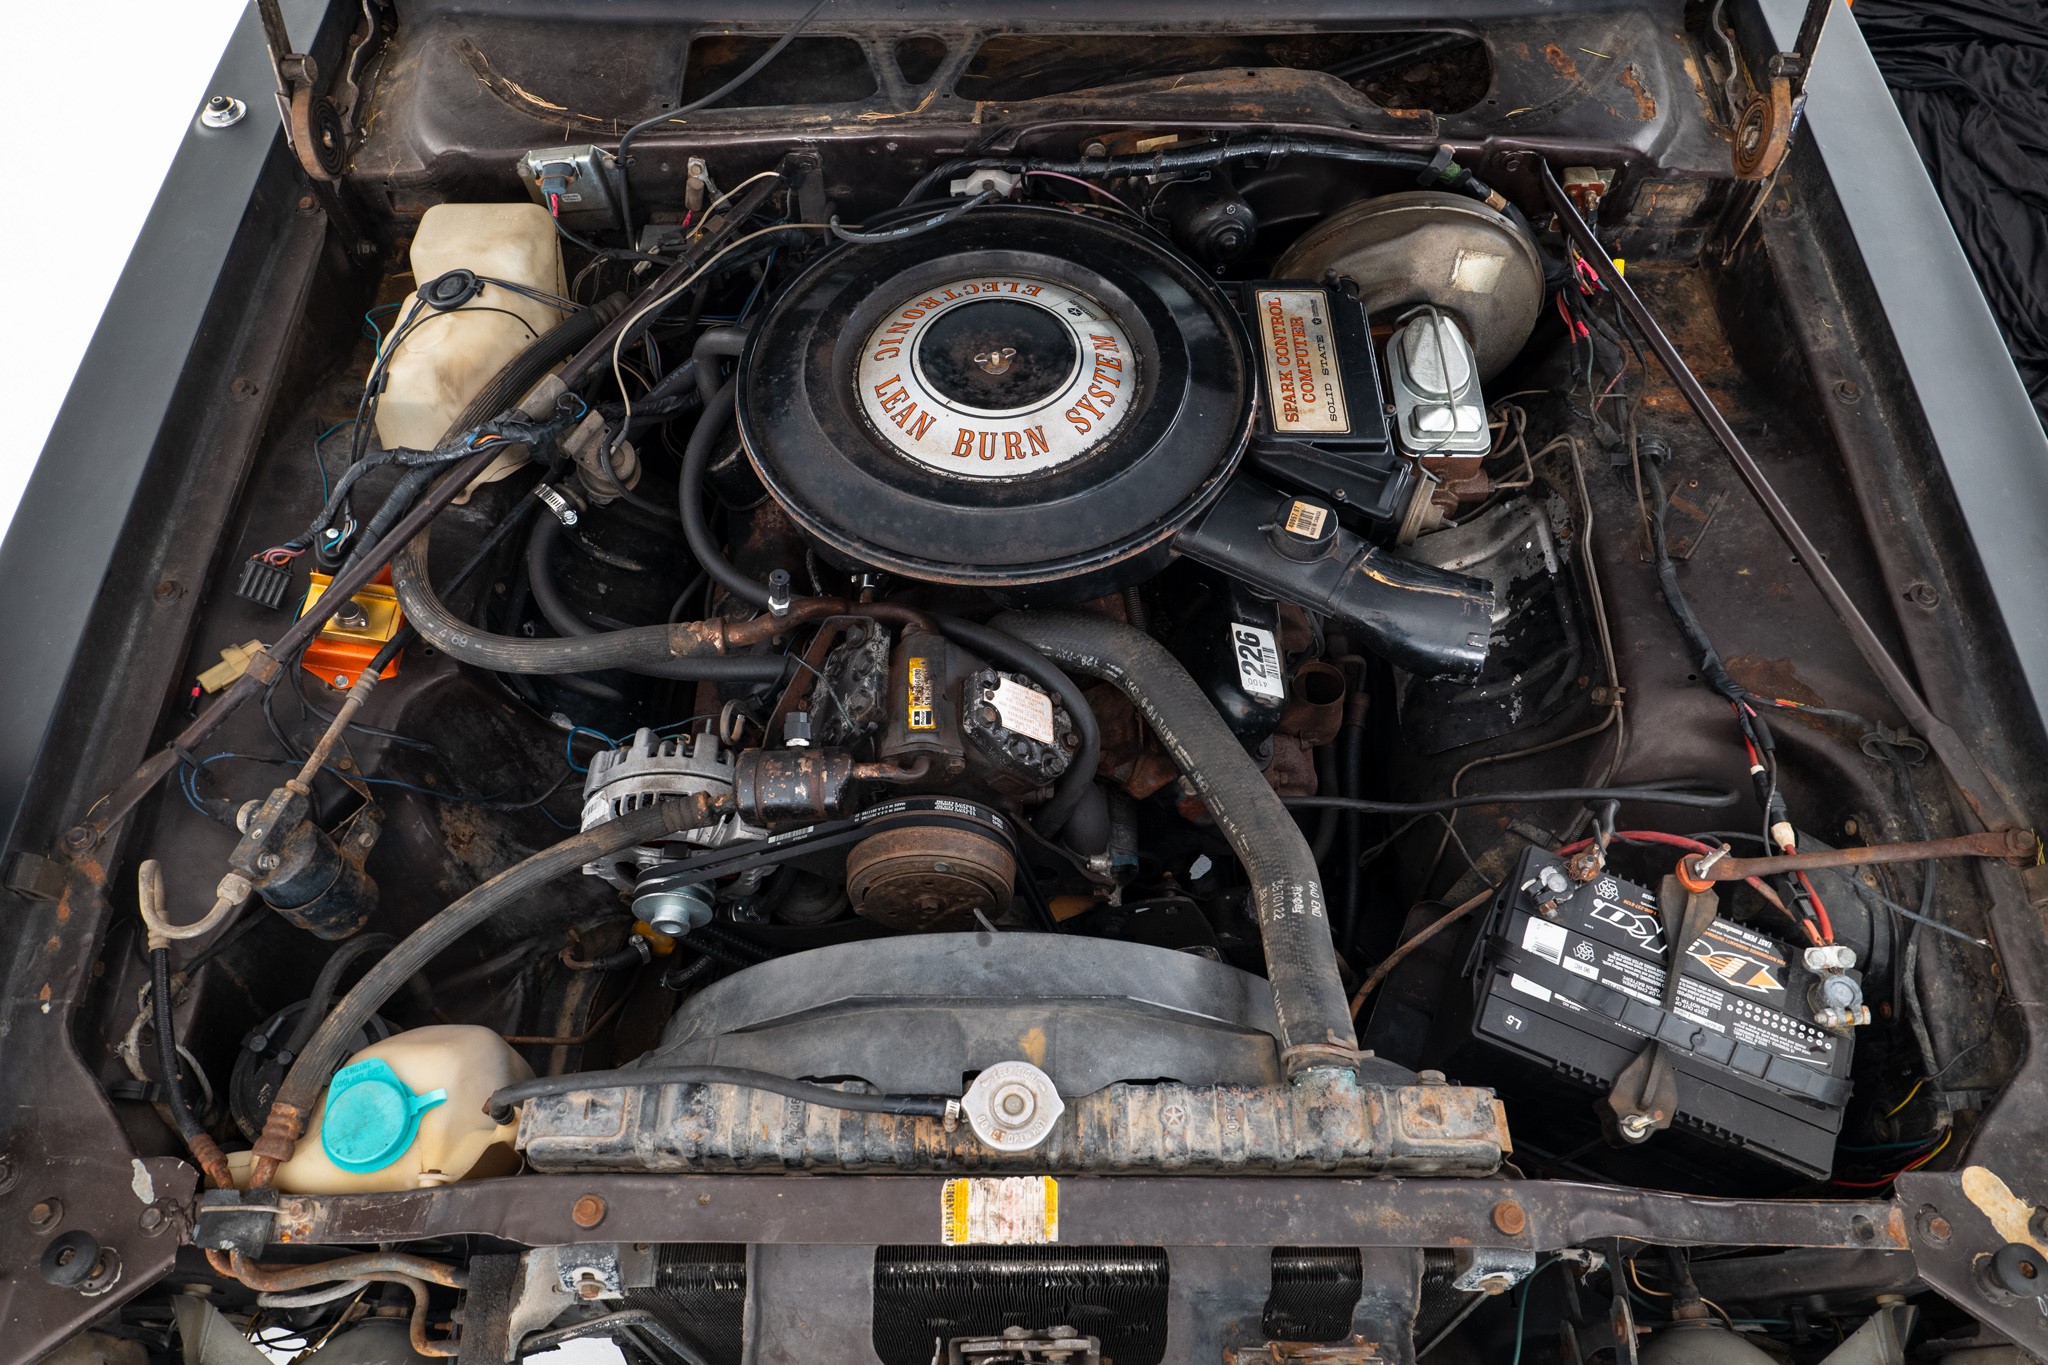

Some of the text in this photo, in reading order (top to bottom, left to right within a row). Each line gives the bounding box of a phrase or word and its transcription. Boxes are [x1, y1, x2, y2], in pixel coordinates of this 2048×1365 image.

[873, 281, 1045, 362] ELECTRONIC
[1269, 297, 1299, 422] SPARK CONTROL
[1290, 316, 1316, 404] COMPUTER
[1317, 335, 1337, 422] SOLID STATE
[874, 333, 1122, 461] LEAN BURN SYSTEM
[1235, 630, 1266, 679] 226
[1573, 962, 1582, 970] RC
[1742, 931, 1757, 943] PENN
[1757, 937, 1772, 948] EAST
[1506, 1014, 1522, 1030] L5
